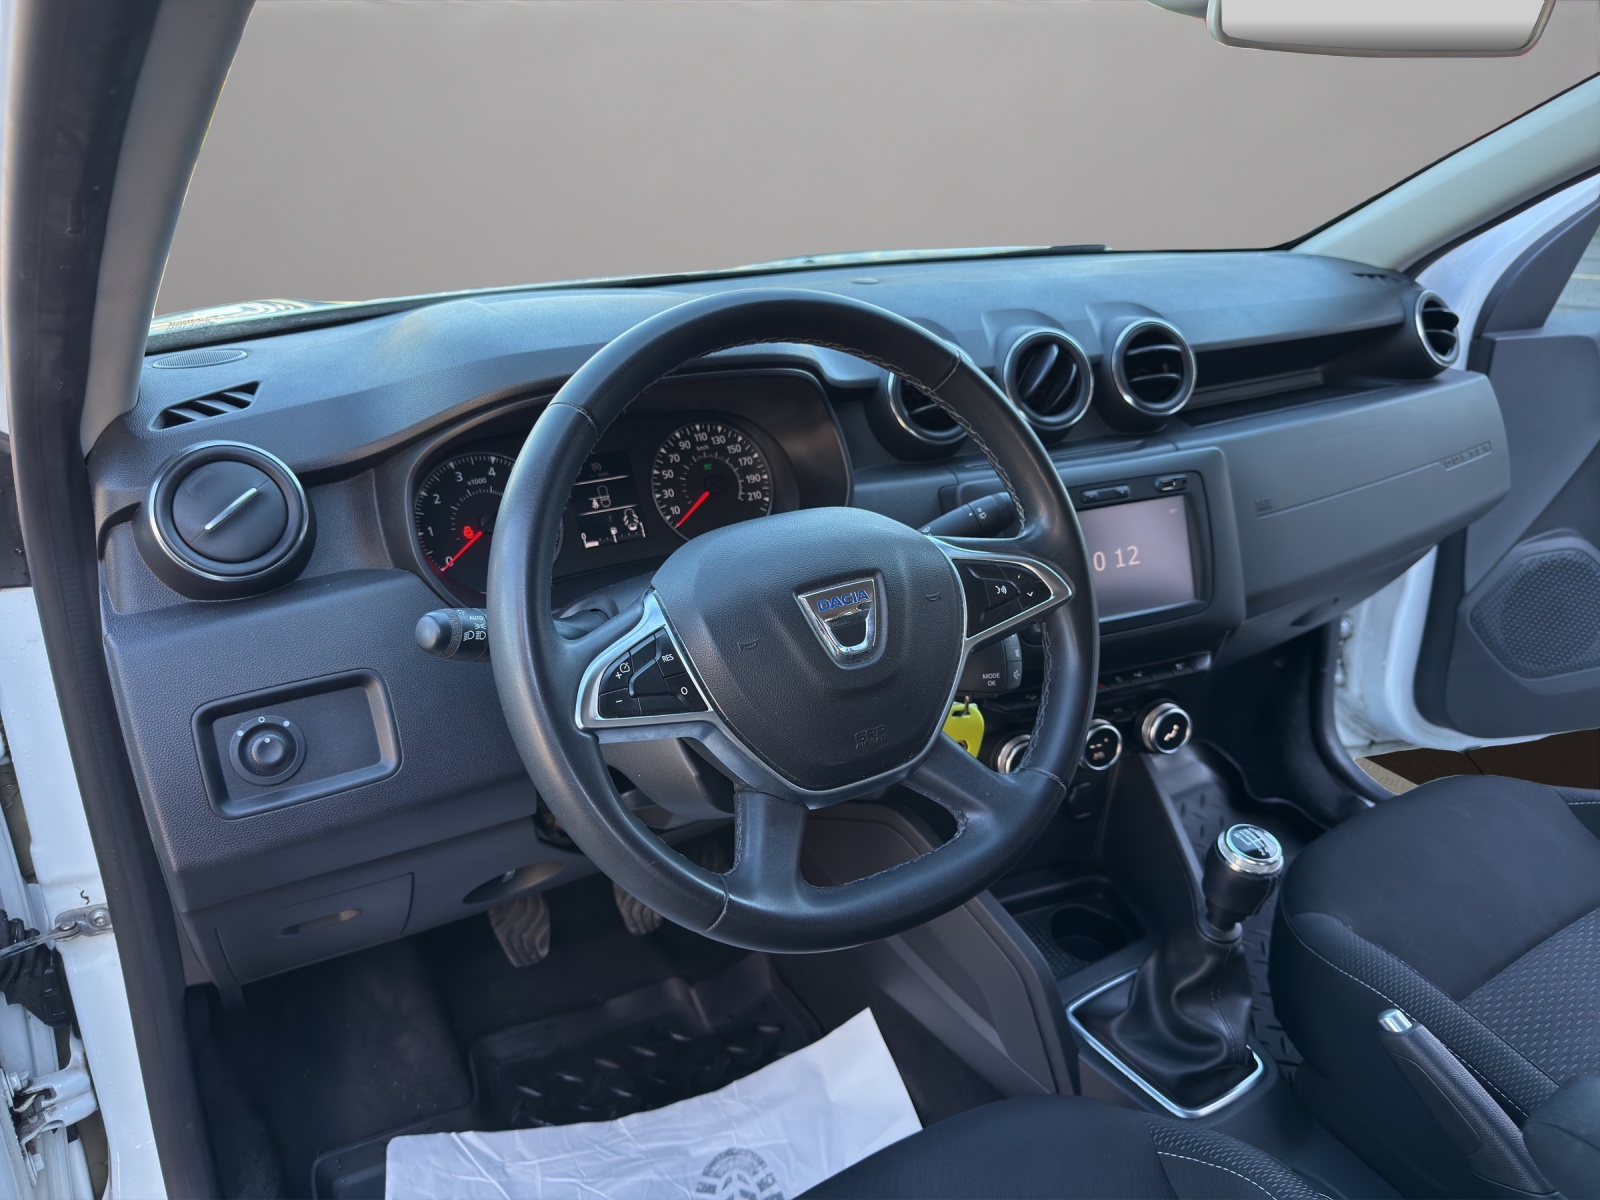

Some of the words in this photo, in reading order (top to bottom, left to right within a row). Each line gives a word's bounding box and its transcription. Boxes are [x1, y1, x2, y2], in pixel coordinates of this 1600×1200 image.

[694, 432, 708, 442] 110
[711, 435, 726, 445] 130
[678, 440, 691, 450] 90
[727, 444, 742, 454] 150
[668, 454, 680, 463] 70
[738, 457, 753, 467] 170
[456, 471, 464, 482] 3
[488, 467, 496, 477] 4
[662, 470, 674, 479] 50
[746, 474, 761, 483] 190
[433, 493, 441, 505] 2
[662, 489, 675, 499] 30
[747, 491, 762, 501] 210
[670, 505, 681, 515] 10
[427, 526, 434, 536] 1
[1114, 545, 1141, 568] 12
[817, 590, 870, 613] DACIA
[661, 654, 674, 663] RES
[982, 672, 1000, 680] MODE
